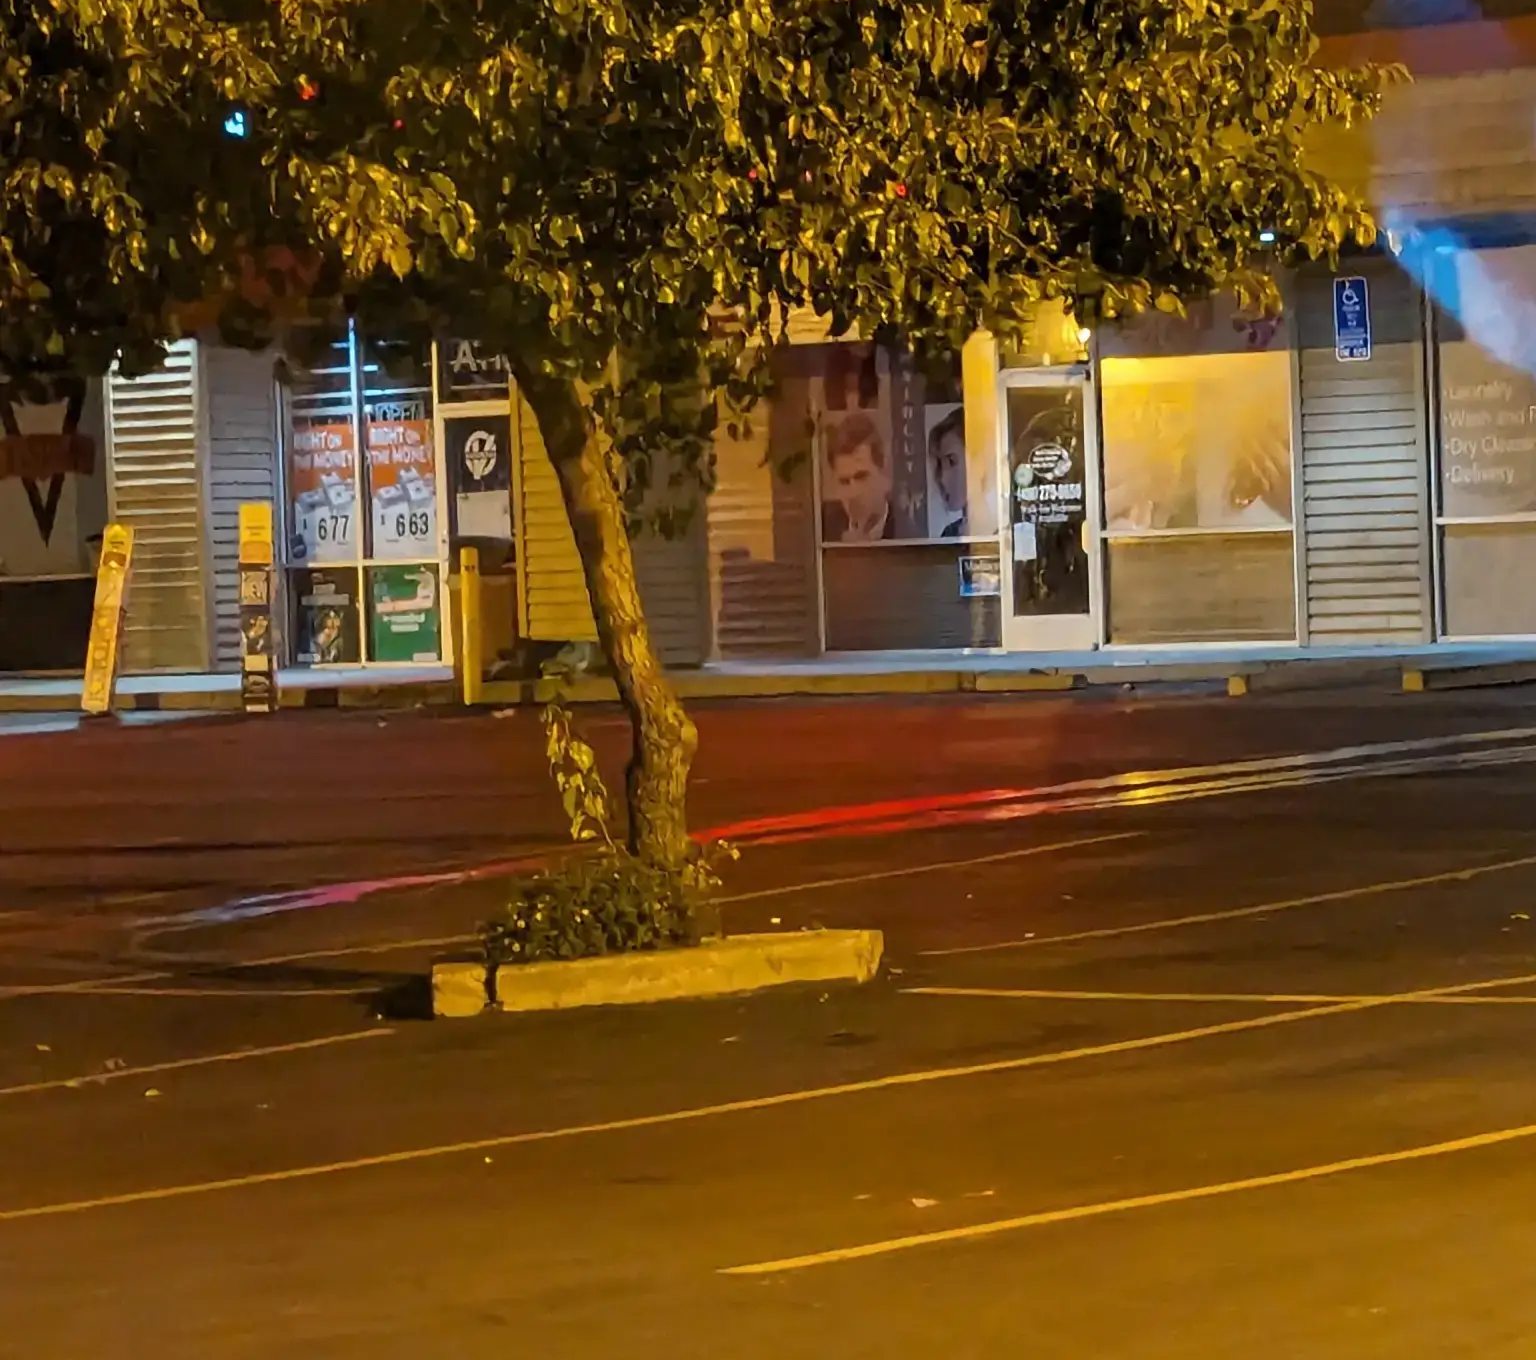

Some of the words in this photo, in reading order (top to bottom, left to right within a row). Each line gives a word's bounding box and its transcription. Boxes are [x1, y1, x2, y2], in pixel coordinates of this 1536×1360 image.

[1450, 437, 1479, 459] Dry
[318, 513, 350, 541] 677
[396, 512, 429, 537] 663
